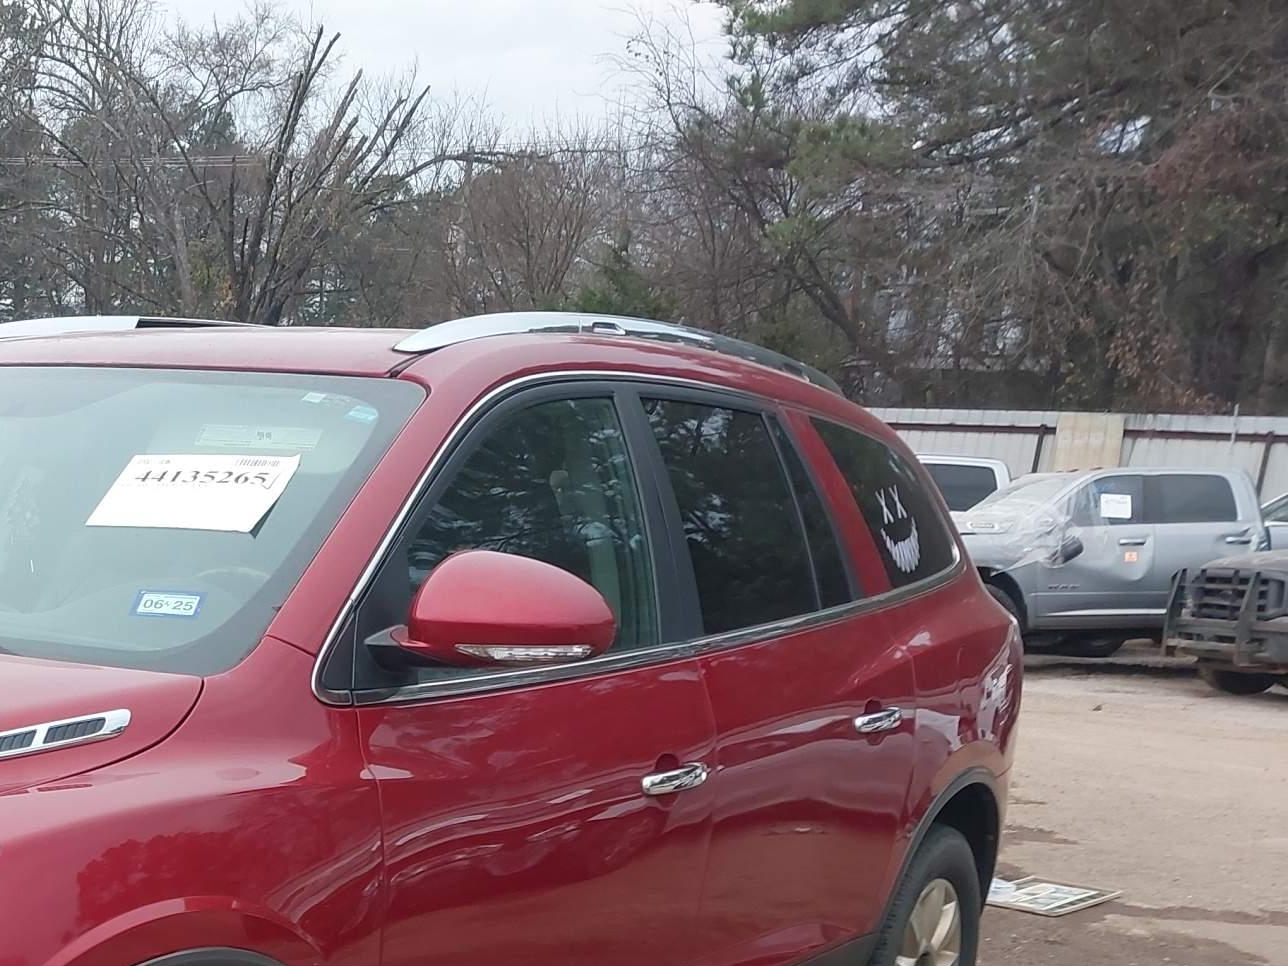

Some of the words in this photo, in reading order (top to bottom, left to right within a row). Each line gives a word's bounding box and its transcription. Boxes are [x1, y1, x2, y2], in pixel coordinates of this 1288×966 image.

[134, 469, 270, 485] 44135265
[143, 599, 165, 609] 06
[171, 600, 195, 611] 25
